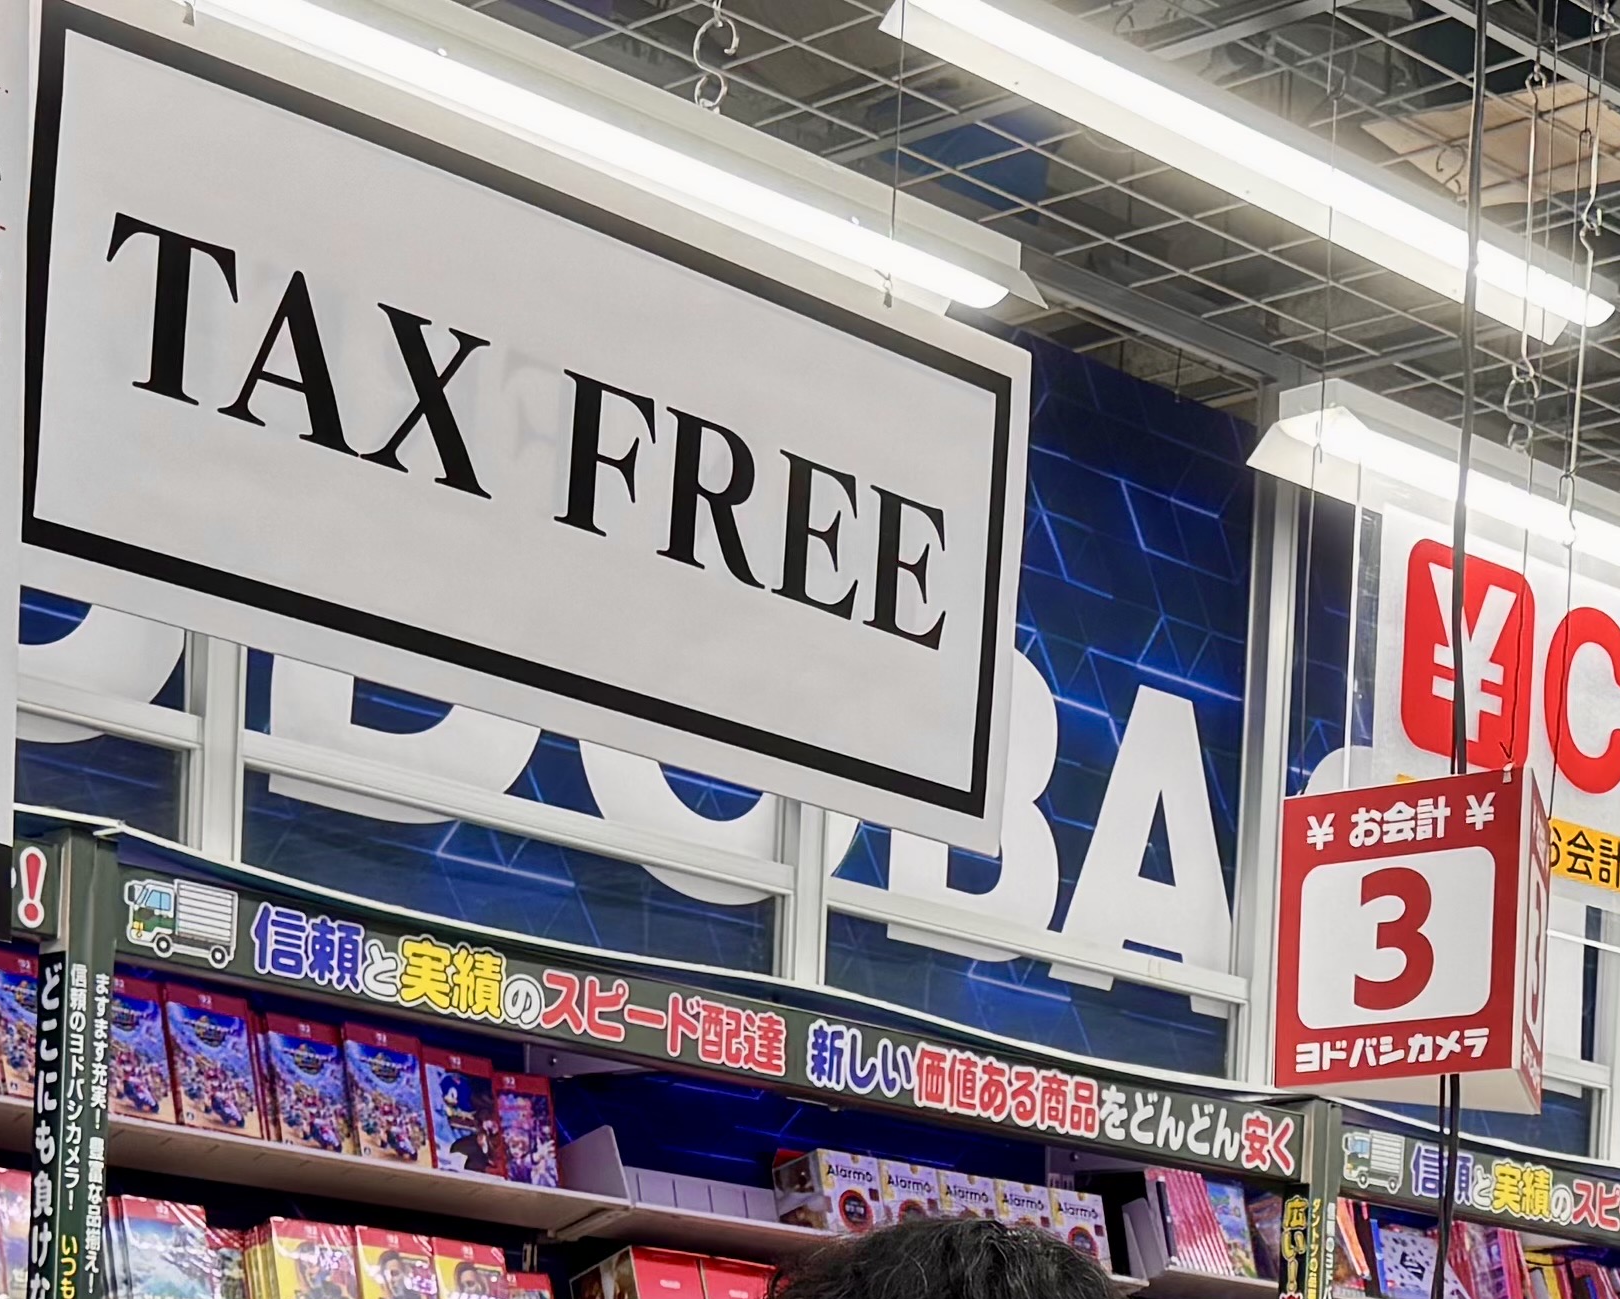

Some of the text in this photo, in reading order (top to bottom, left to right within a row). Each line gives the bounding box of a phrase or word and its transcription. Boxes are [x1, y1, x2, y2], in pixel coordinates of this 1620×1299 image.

[106, 210, 950, 652] TAX FREE
[1348, 795, 1451, 847] お会計
[1353, 867, 1435, 1011] 3
[252, 902, 1296, 1176] 信頼と実績のスピード配達 新しい価値ある商品をどんどん安く
[1295, 1027, 1490, 1073] ヨドバシカメラ
[825, 1162, 874, 1186] Alarmo
